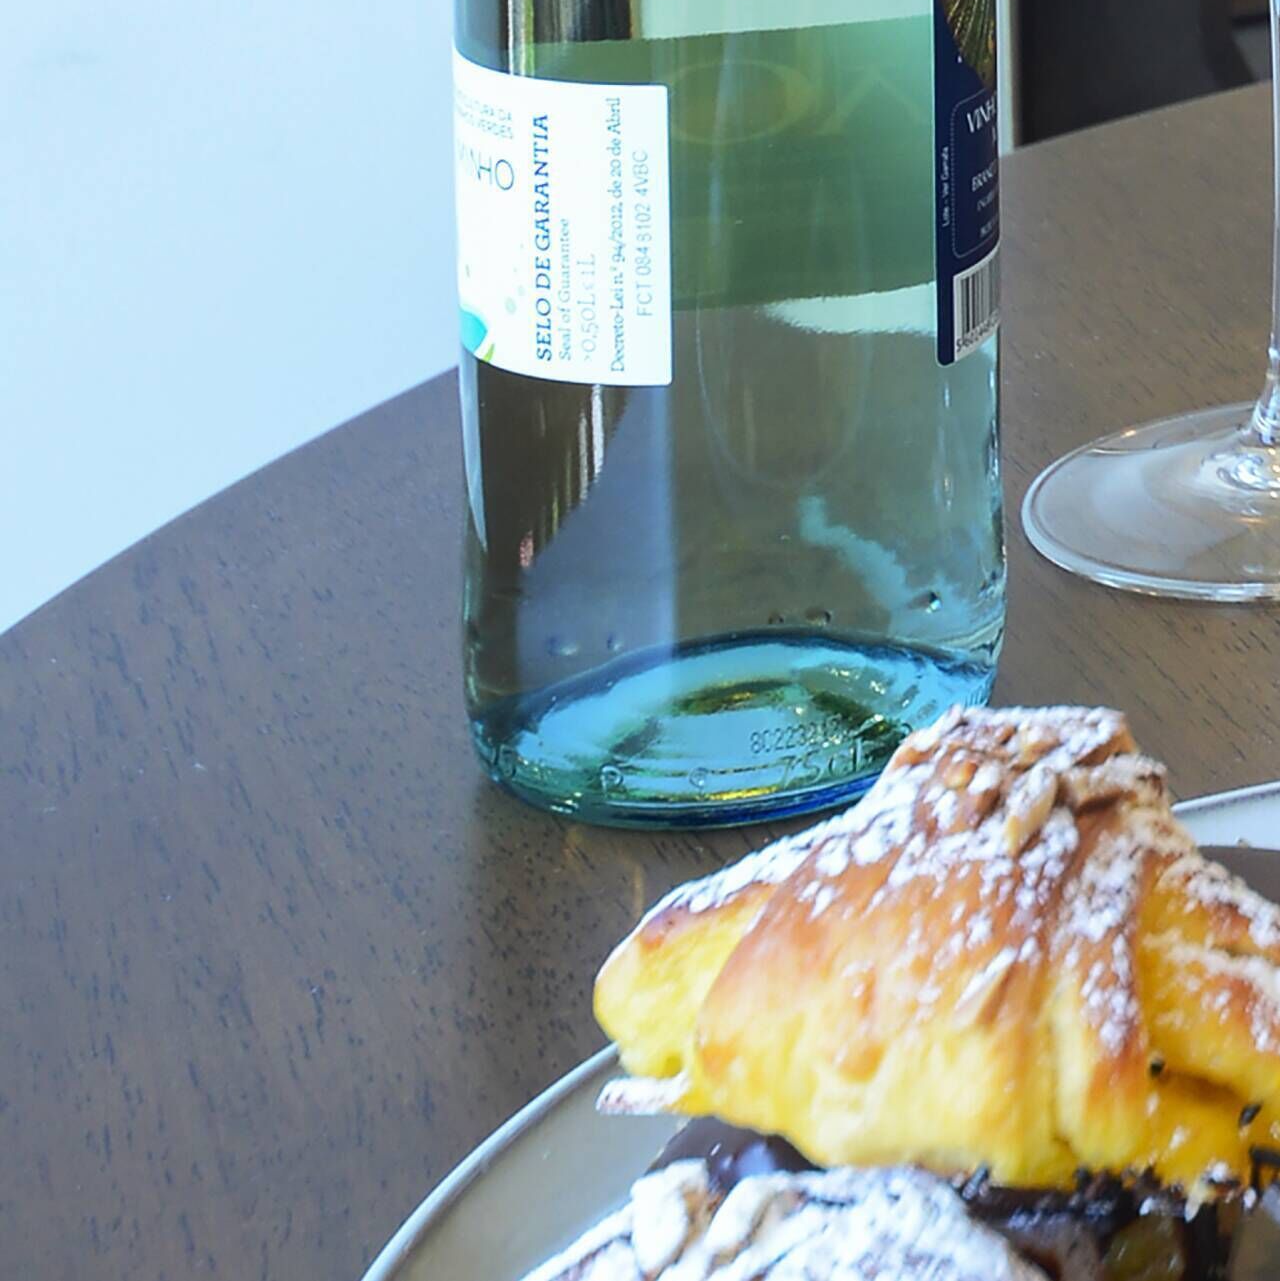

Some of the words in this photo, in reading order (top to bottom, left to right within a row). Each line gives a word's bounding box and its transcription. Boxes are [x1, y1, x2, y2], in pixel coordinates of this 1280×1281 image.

[604, 96, 622, 136] Abril
[605, 137, 622, 157] de
[532, 114, 551, 251] GARANTIA
[609, 158, 623, 178] 20
[606, 179, 624, 199] de
[535, 256, 552, 290] DE
[556, 218, 571, 303] Guarantee
[556, 305, 571, 324] of
[634, 281, 654, 317] FCT
[535, 297, 553, 362] SELO
[555, 327, 572, 361] Seal
